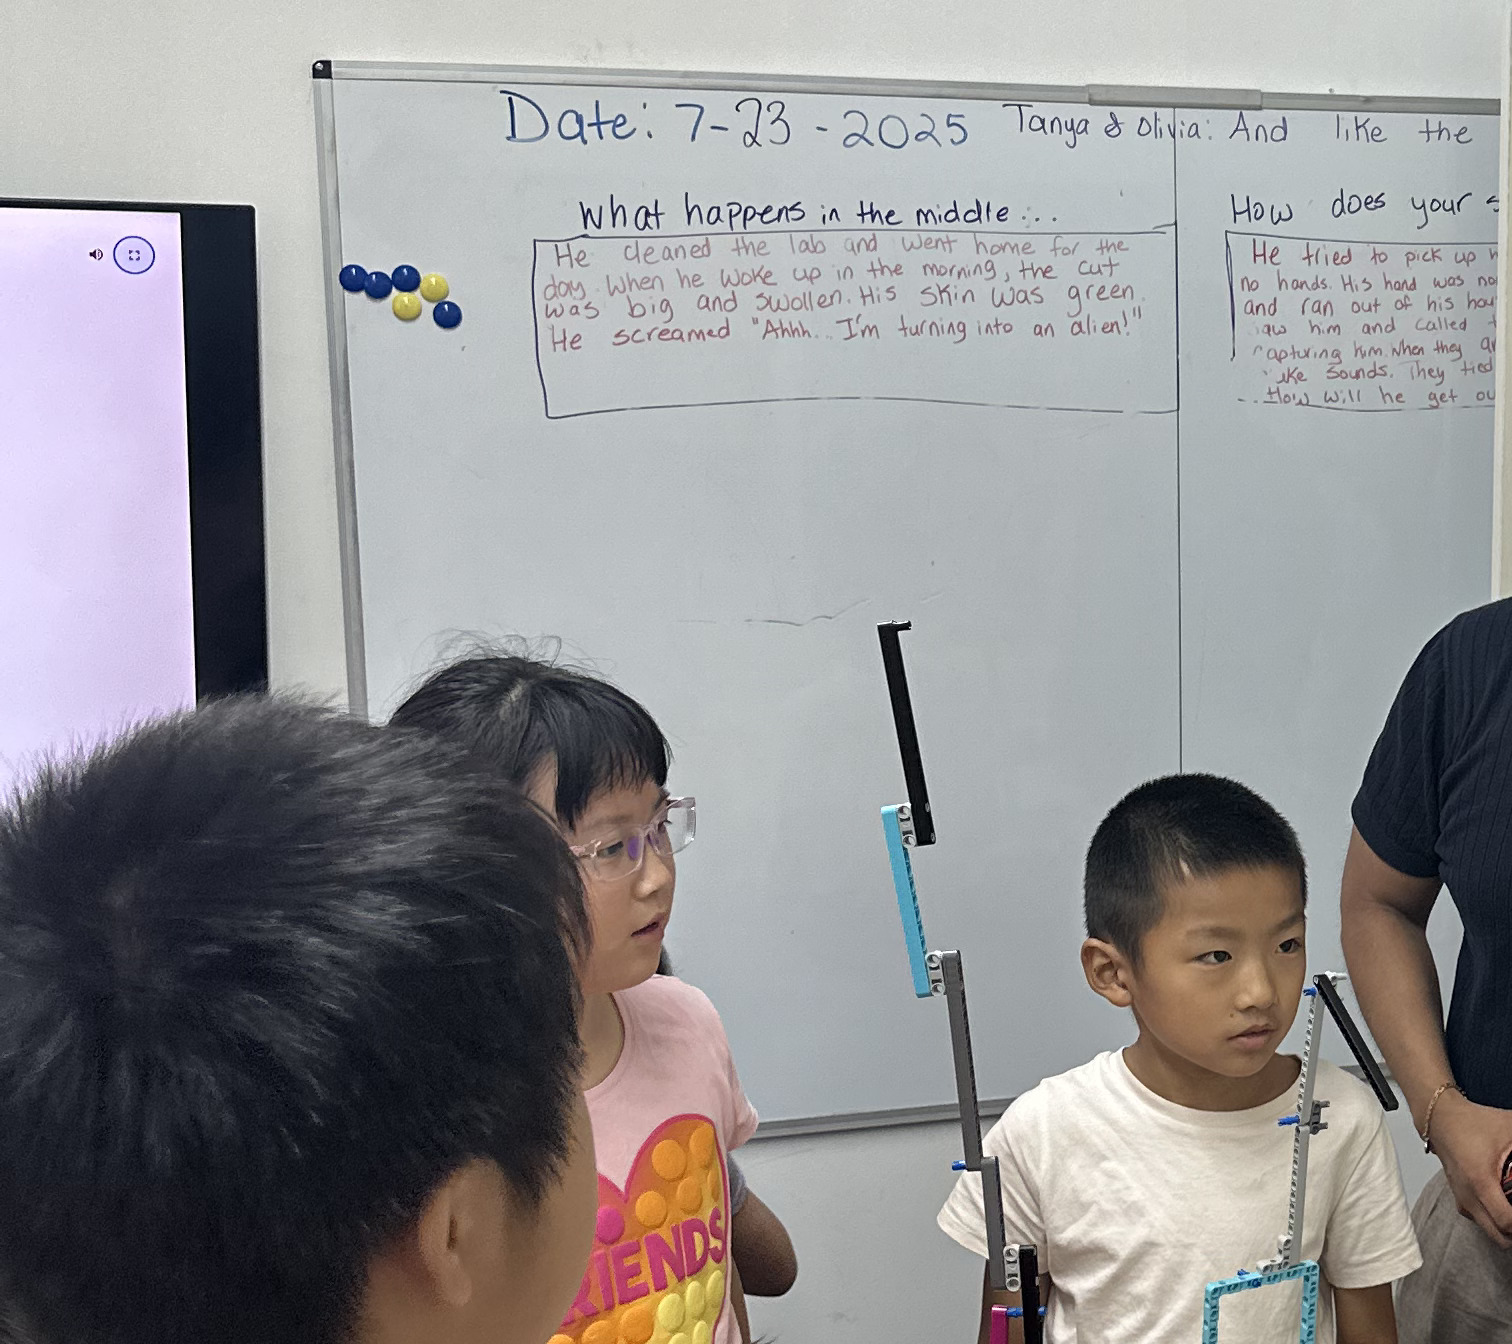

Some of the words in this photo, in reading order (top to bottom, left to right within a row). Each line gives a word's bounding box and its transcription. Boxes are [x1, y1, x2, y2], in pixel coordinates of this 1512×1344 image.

[499, 89, 654, 144] Date:
[675, 97, 792, 149] 7-23
[842, 109, 969, 150] 2025
[1003, 103, 1090, 149] Tanya
[1228, 109, 1290, 144] And
[1418, 114, 1474, 145] the
[579, 193, 665, 232] What
[684, 191, 806, 232] happens
[821, 205, 841, 225] in
[856, 199, 903, 226] the
[1230, 193, 1293, 226] How
[1331, 188, 1387, 218] does
[1411, 192, 1473, 231] your
[555, 243, 591, 269] He
[624, 237, 713, 266] cleaned
[731, 236, 771, 257] the
[789, 233, 827, 256] lab
[845, 232, 878, 254] and
[974, 232, 1036, 256] home
[1049, 234, 1080, 258] for
[1095, 237, 1130, 253] the
[1252, 237, 1283, 267] He
[1303, 241, 1353, 267] tried
[1369, 246, 1389, 265] to
[1405, 247, 1443, 272] pick
[1453, 250, 1477, 270] up
[675, 267, 705, 289] he
[793, 266, 822, 286] up
[836, 264, 854, 281] in
[867, 256, 904, 278] the
[1018, 260, 1058, 281] the
[1077, 256, 1120, 277] cut
[1240, 276, 1260, 293] no
[1340, 273, 1373, 293] His
[1383, 271, 1417, 292] hand
[1432, 275, 1465, 289] was
[545, 301, 601, 320] was
[627, 294, 675, 324] big
[697, 289, 739, 314] and
[861, 284, 898, 307] His
[1243, 296, 1278, 317] and
[1300, 296, 1335, 317] ran
[1351, 299, 1382, 315] out
[1394, 295, 1414, 312] of
[1426, 293, 1455, 311] his
[551, 324, 583, 354] He
[611, 316, 731, 347] screamed
[897, 313, 968, 344] turning
[976, 318, 1014, 336] into
[1033, 321, 1055, 338] an
[1309, 319, 1342, 336] him
[1361, 316, 1397, 335] and
[1414, 316, 1469, 331] called
[1433, 340, 1463, 362] they
[1323, 388, 1361, 404] will
[1379, 385, 1406, 404] he
[1428, 391, 1458, 409] get
[563, 1206, 727, 1328] RIENDS
